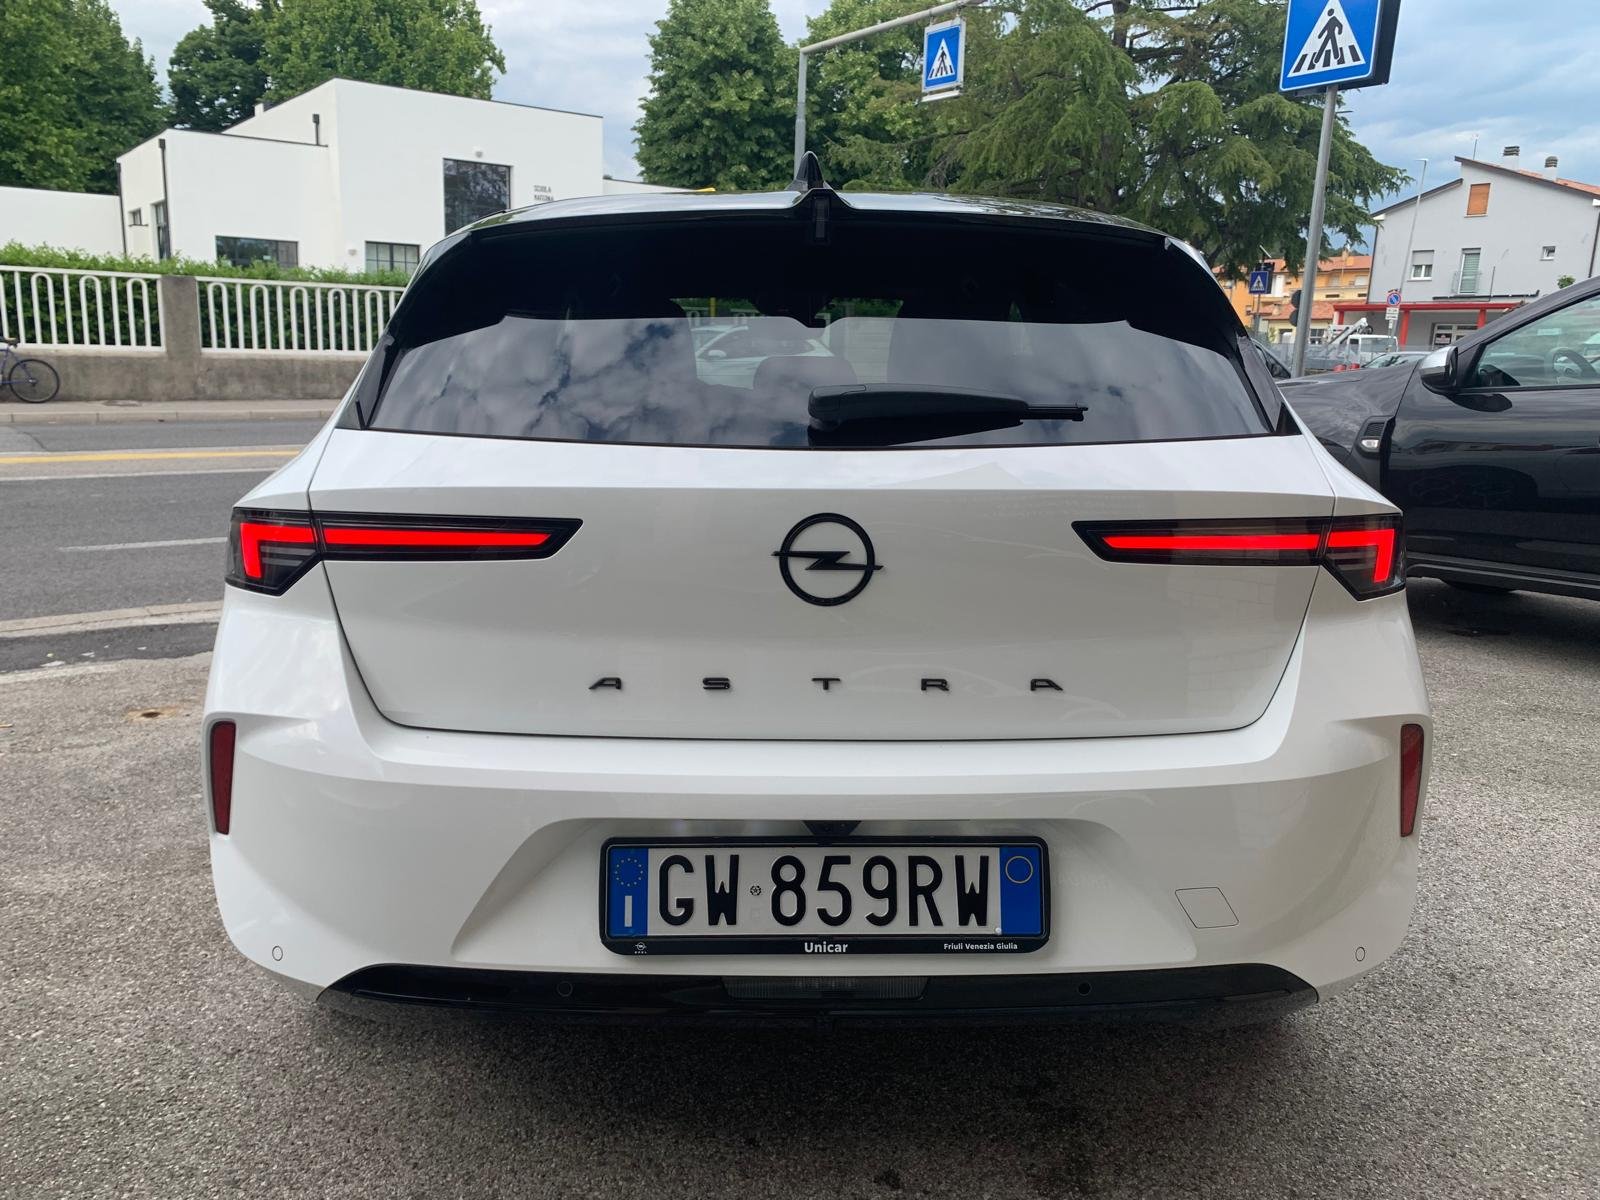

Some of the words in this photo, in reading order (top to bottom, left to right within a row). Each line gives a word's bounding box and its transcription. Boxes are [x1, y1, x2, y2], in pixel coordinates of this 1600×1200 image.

[588, 677, 1065, 692] ASTRA
[803, 941, 849, 953] Unicar
[943, 942, 964, 951] Friuli
[965, 942, 995, 951] Venezia
[996, 942, 1018, 951] Giulia
